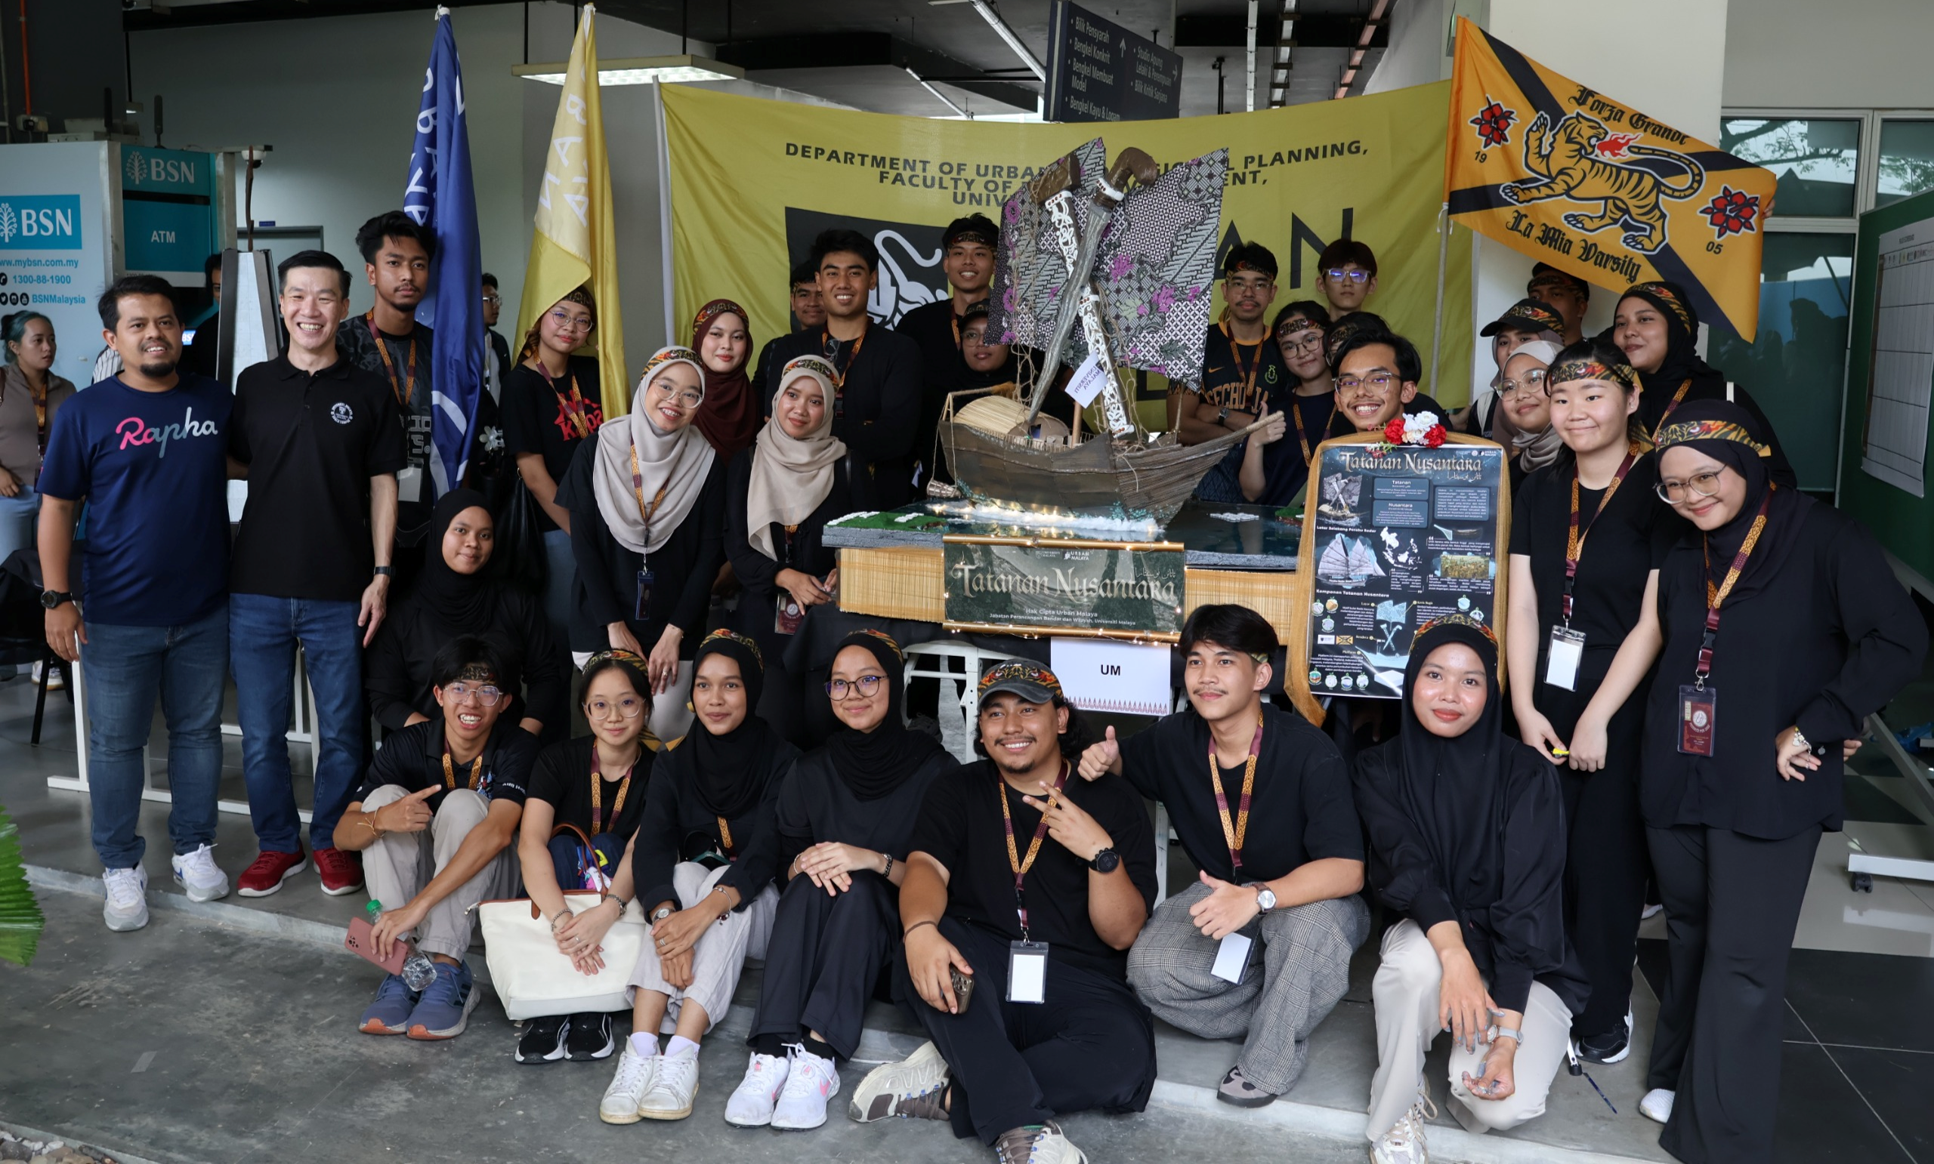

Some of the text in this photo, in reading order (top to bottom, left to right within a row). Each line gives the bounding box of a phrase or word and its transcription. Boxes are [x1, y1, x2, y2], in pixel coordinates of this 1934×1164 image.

[1086, 21, 1110, 44] Pensyarah
[1074, 37, 1093, 57] Bengkel
[1072, 57, 1092, 77] Bengkel
[1568, 84, 1626, 123] Forza
[785, 142, 1046, 179] DEPARTMENT OF URBA
[1243, 140, 1369, 171] PLANNING,
[1473, 150, 1488, 164] 19
[150, 158, 196, 184] BSN
[879, 170, 975, 192] FACULTY
[984, 180, 1013, 194] OF
[21, 208, 73, 237] BSN
[150, 229, 176, 244] ATM
[1505, 209, 1642, 284] La Mia Varsity
[1706, 240, 1724, 255] 05
[12, 275, 72, 285] 1300-88-1900
[32, 294, 86, 306] BSNMalaysia
[115, 407, 219, 459] Rapha
[1338, 451, 1482, 474] Tatanan Nusantara
[951, 563, 1177, 603] Tatanan Nusantara
[1100, 664, 1121, 676] UM
